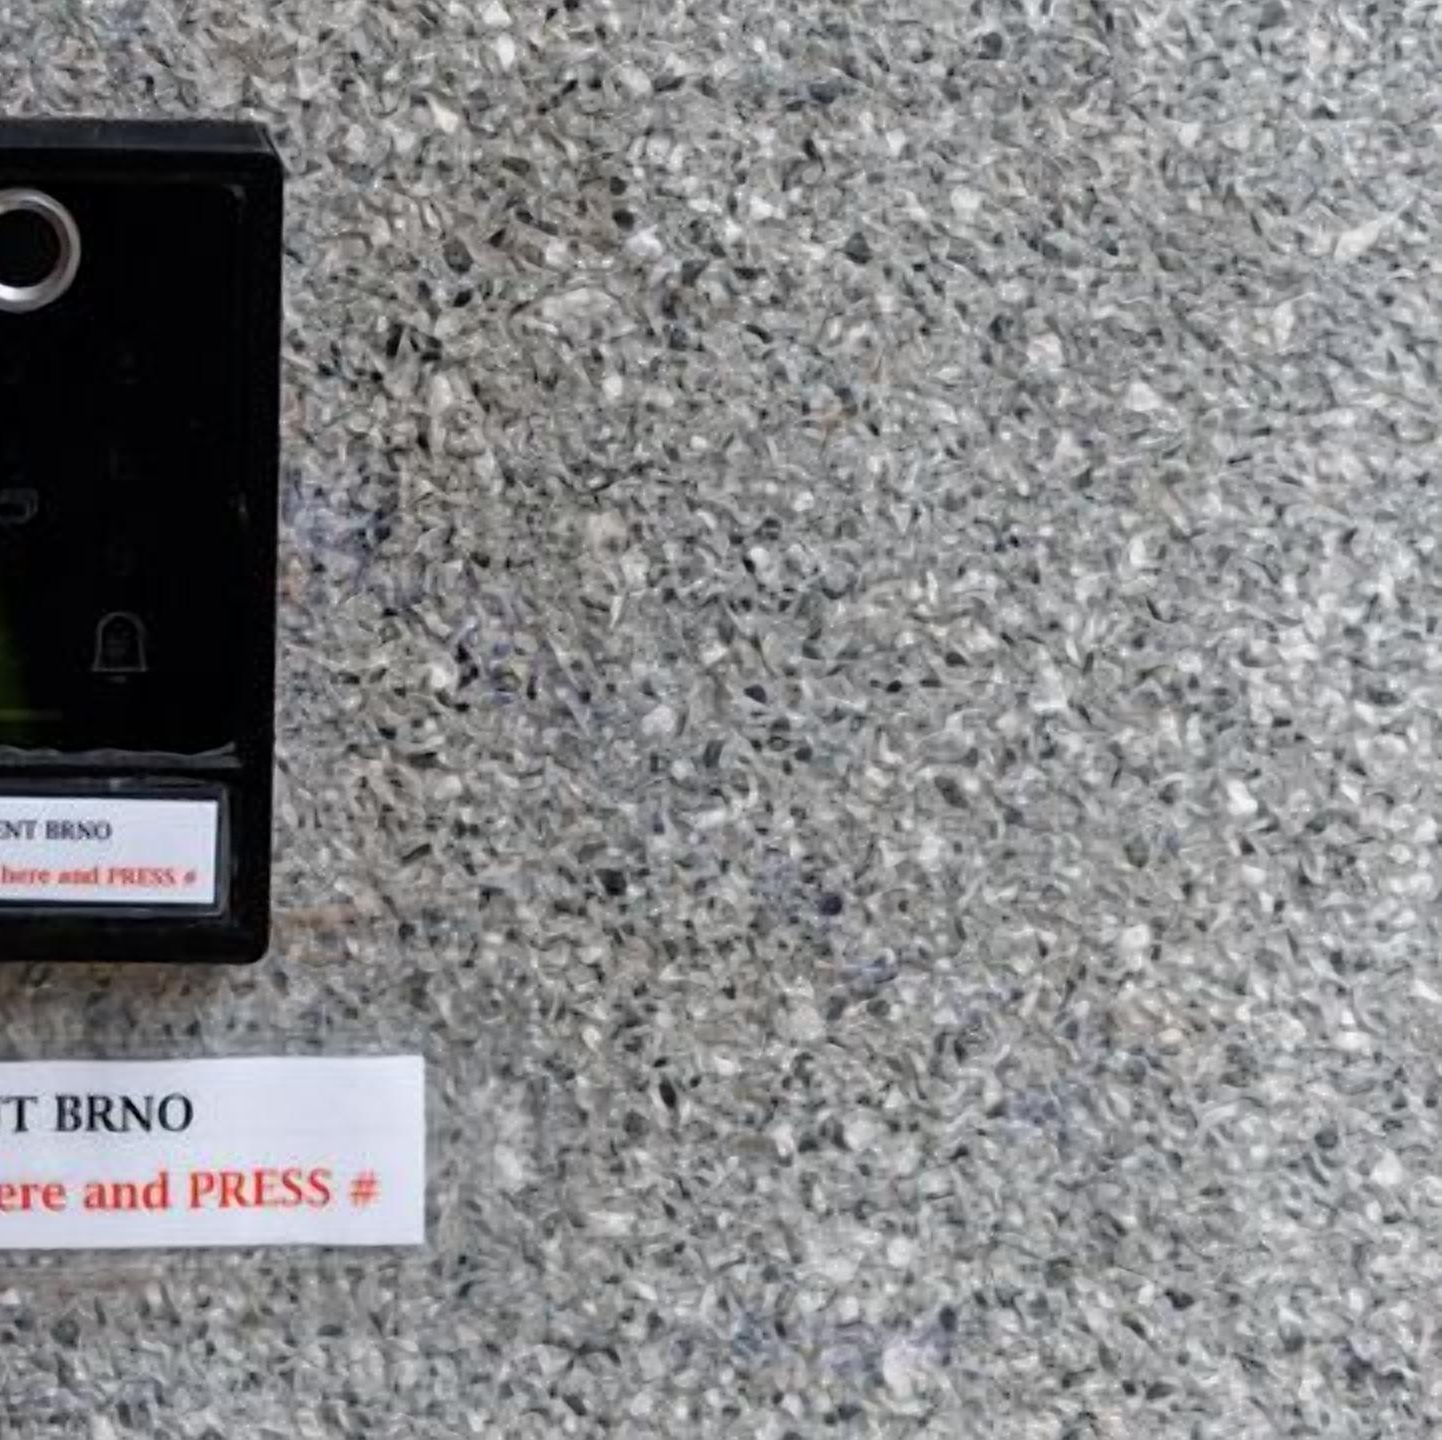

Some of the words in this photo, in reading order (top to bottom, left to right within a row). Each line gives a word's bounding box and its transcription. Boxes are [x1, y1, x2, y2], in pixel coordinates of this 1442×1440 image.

[45, 820, 114, 841] BRNO
[1, 866, 51, 886] here
[58, 866, 99, 886] and
[108, 867, 177, 887] PRESS
[182, 870, 197, 886] #
[57, 1096, 194, 1133] BRNO
[85, 1169, 175, 1213] and
[190, 1167, 334, 1211] PRESS
[351, 1173, 377, 1205] #
